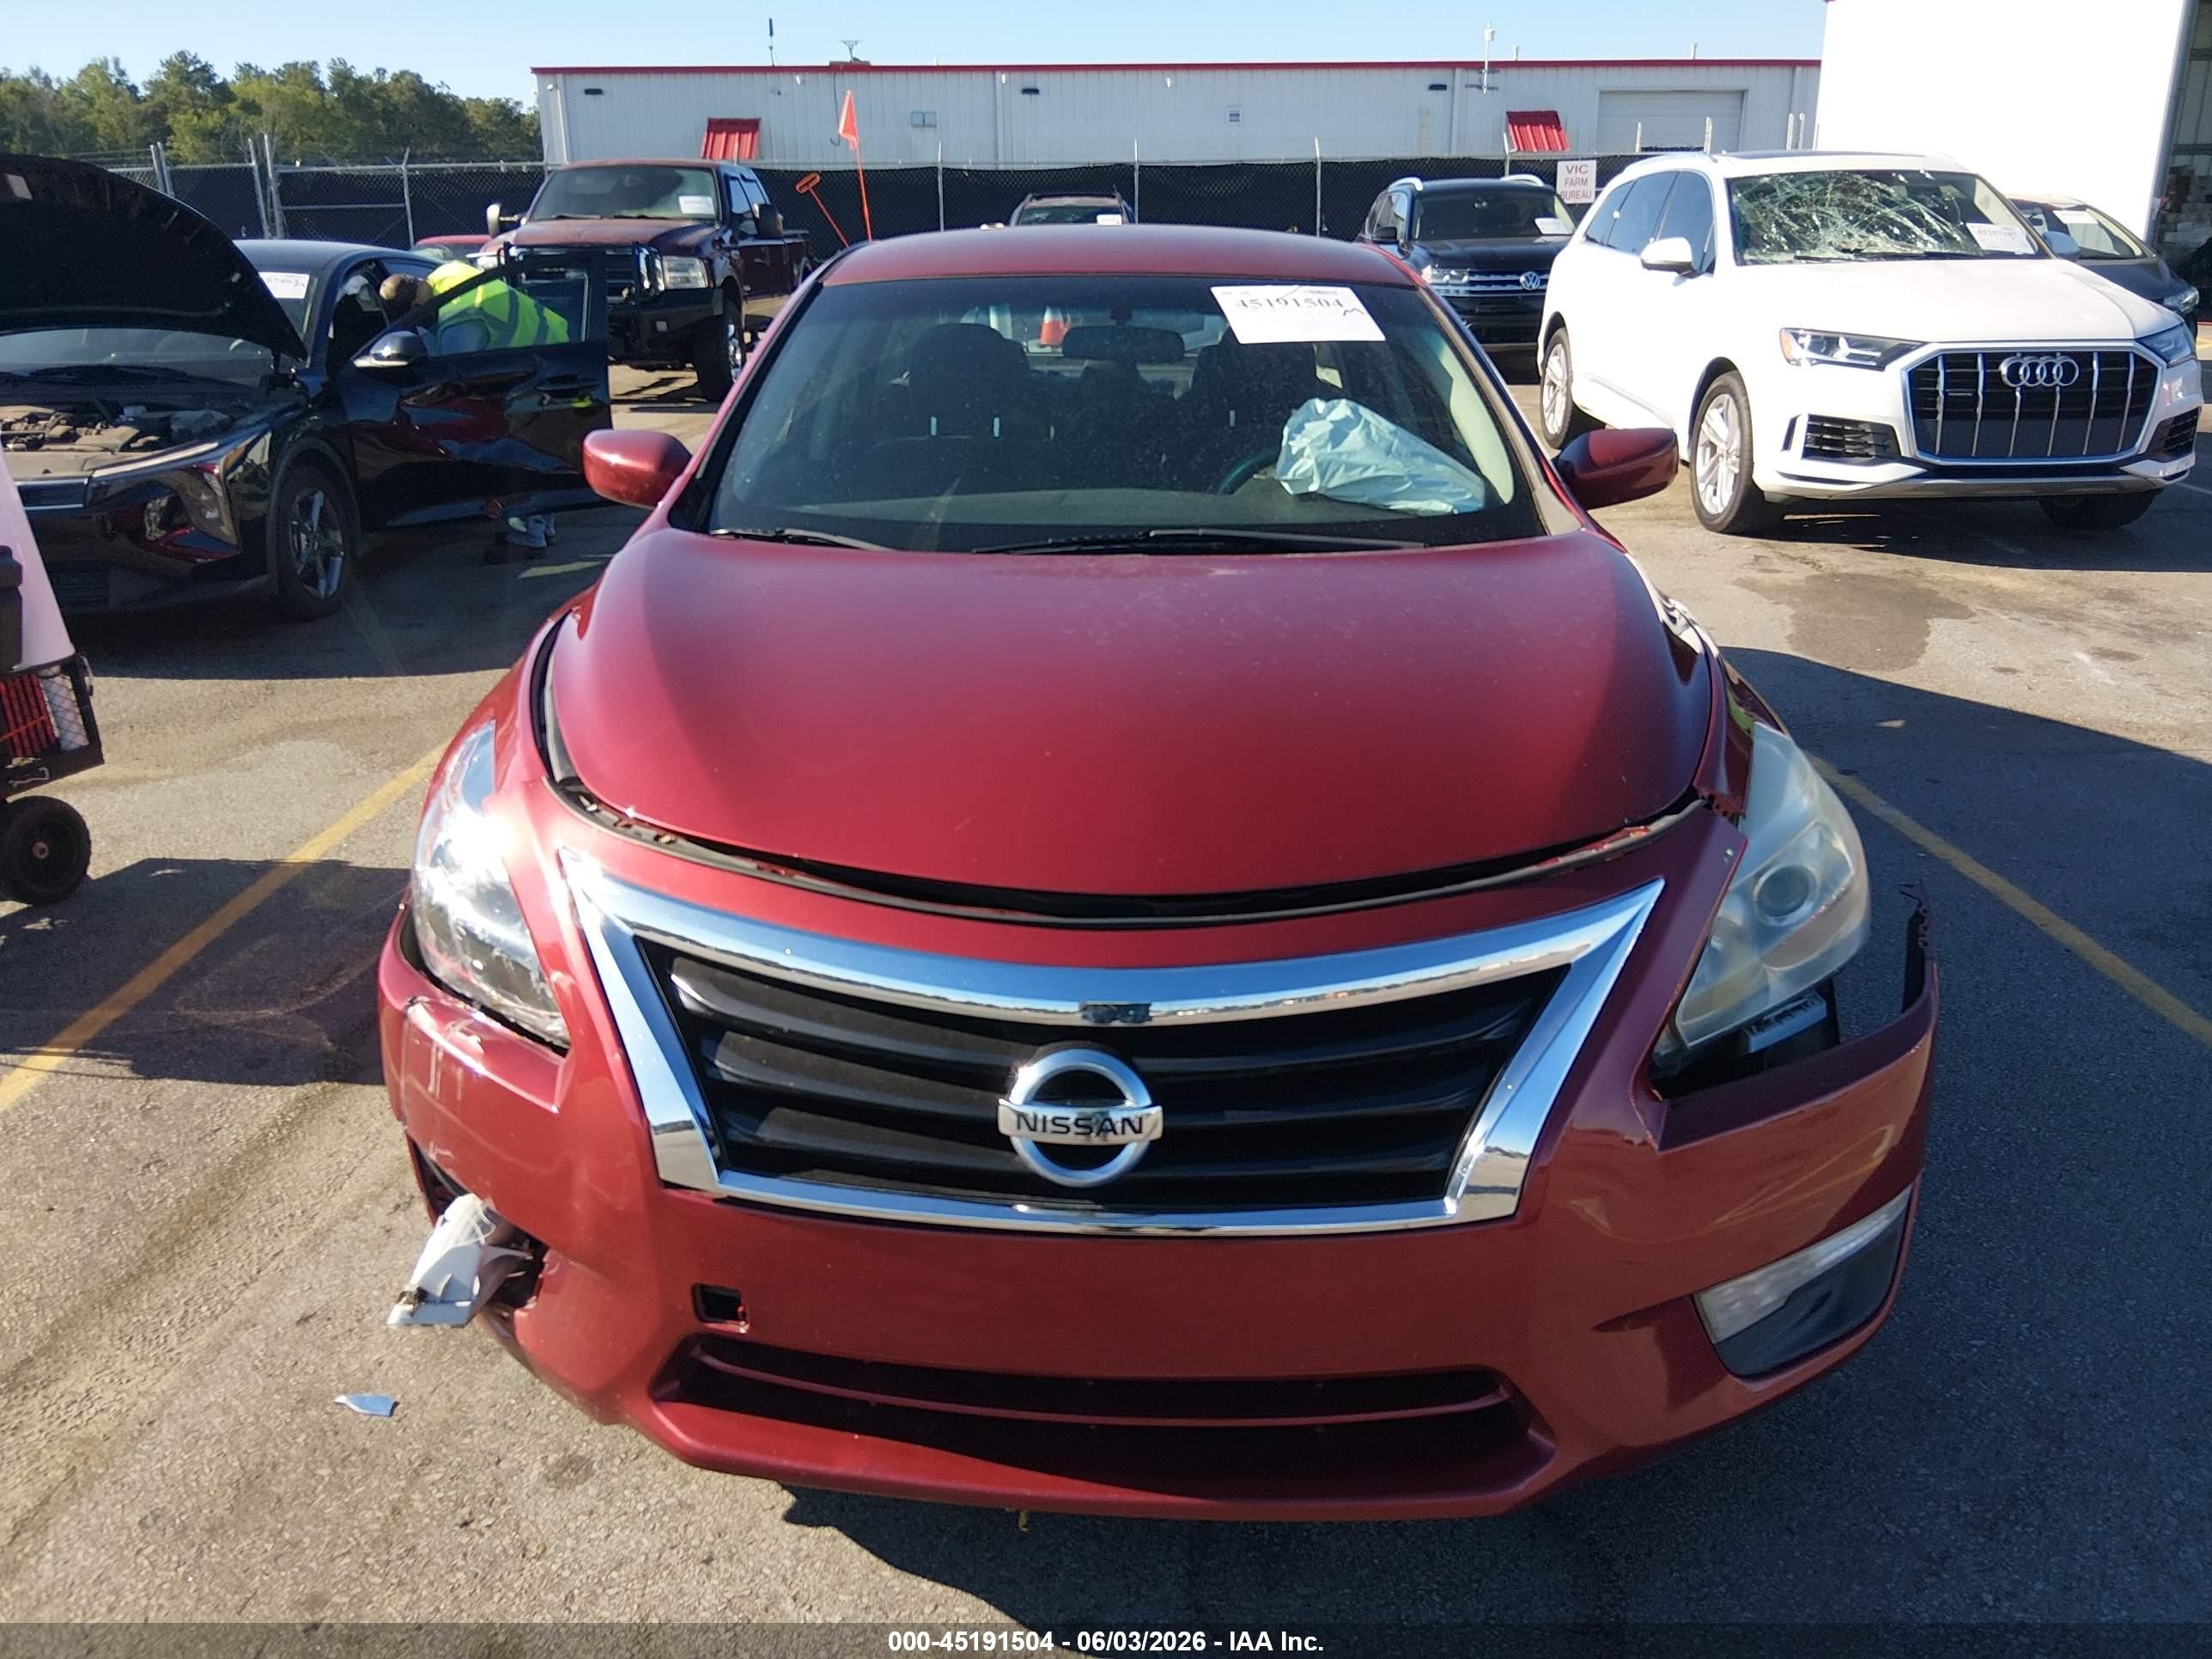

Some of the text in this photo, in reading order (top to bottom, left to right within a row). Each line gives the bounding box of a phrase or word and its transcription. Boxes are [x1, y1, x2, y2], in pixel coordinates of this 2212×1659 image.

[1565, 164, 1589, 174] VIC
[1565, 178, 1588, 187] FARM
[1559, 190, 1592, 200] BUREAU
[1237, 298, 1344, 310] 45191504
[1016, 1112, 1144, 1136] NISSAN
